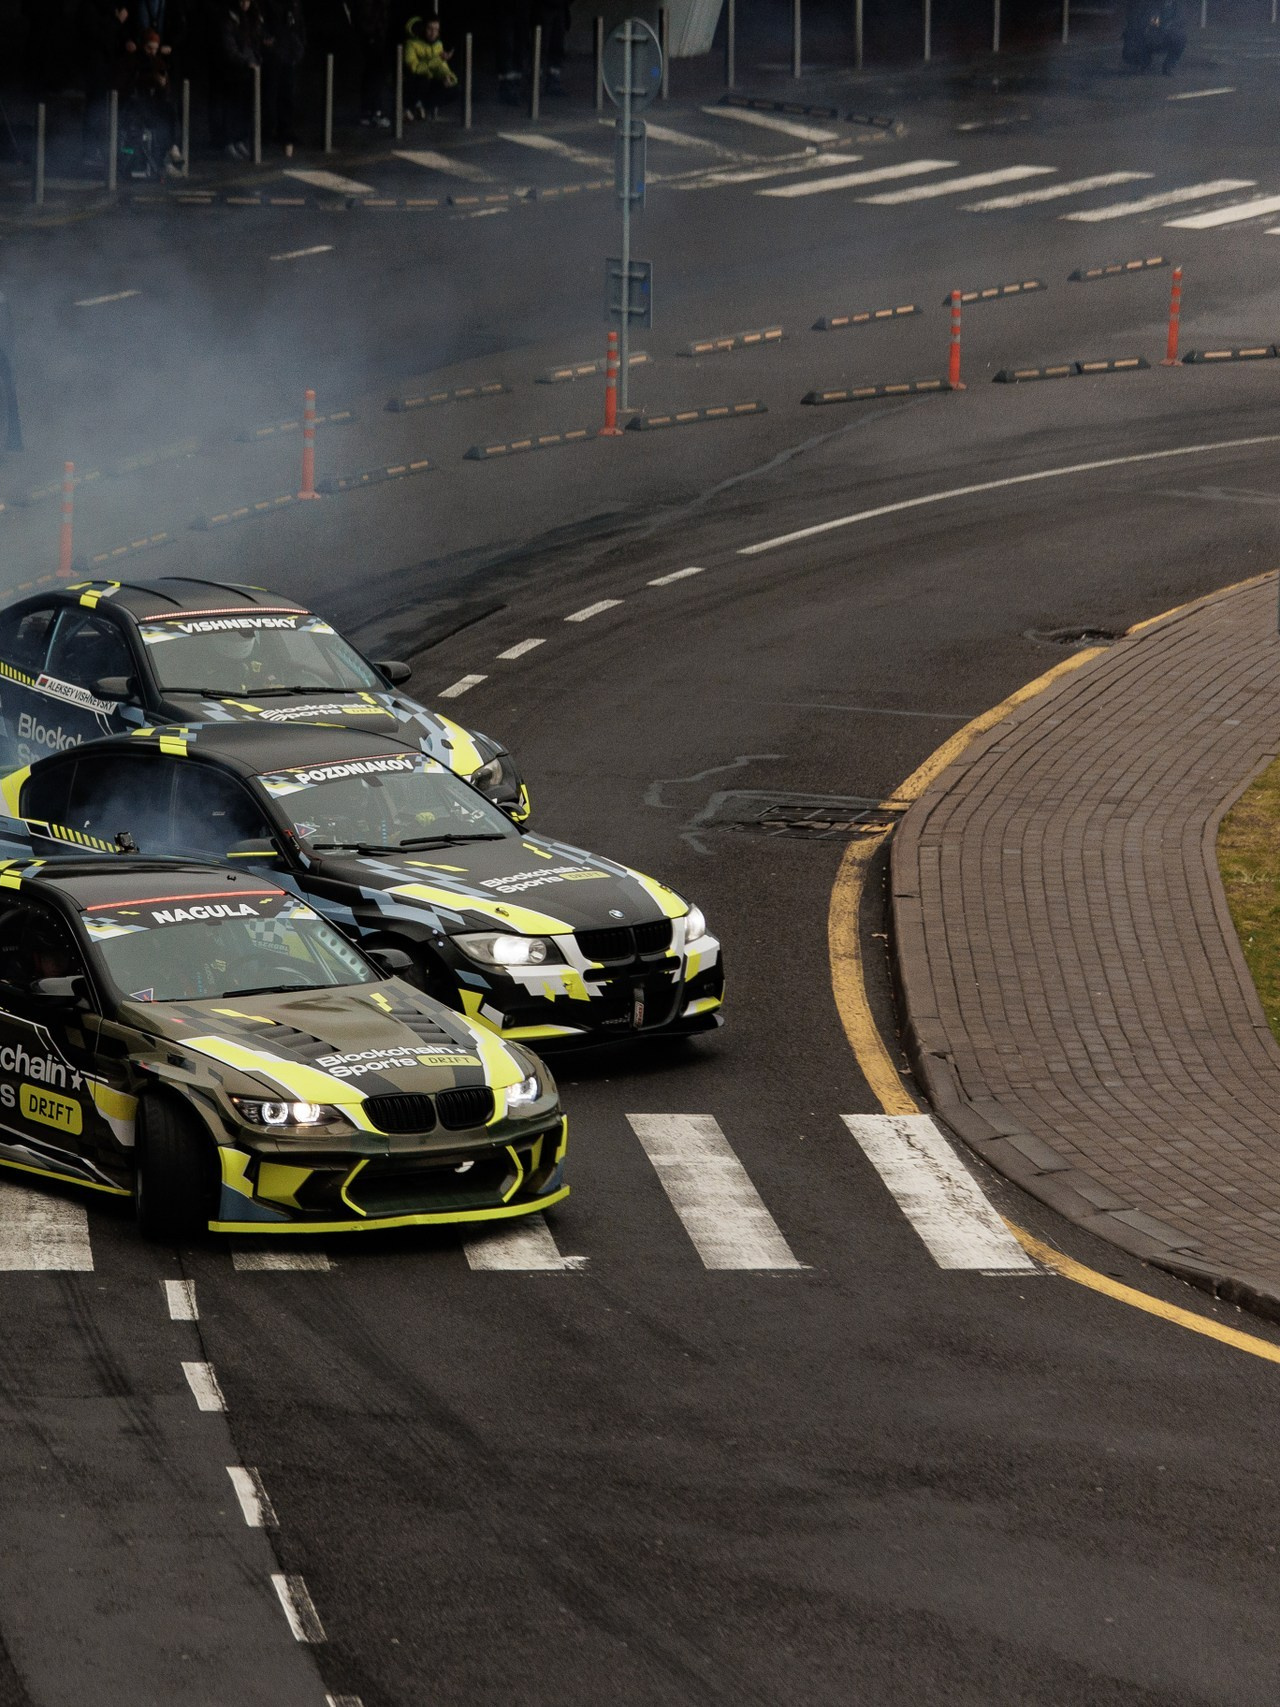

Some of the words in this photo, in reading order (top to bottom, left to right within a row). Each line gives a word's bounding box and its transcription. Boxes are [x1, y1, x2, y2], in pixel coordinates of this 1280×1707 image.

[178, 618, 297, 634] VISHNEVSKY
[47, 681, 76, 697] ALEKSEY
[294, 759, 415, 785] POZDNIAKOV
[480, 866, 583, 888] Blockchain
[496, 876, 564, 893] Sports
[151, 903, 260, 924] NAGULA
[315, 1045, 454, 1068] Blockchain
[328, 1058, 418, 1077] Sports
[29, 1094, 73, 1124] DRIFT
